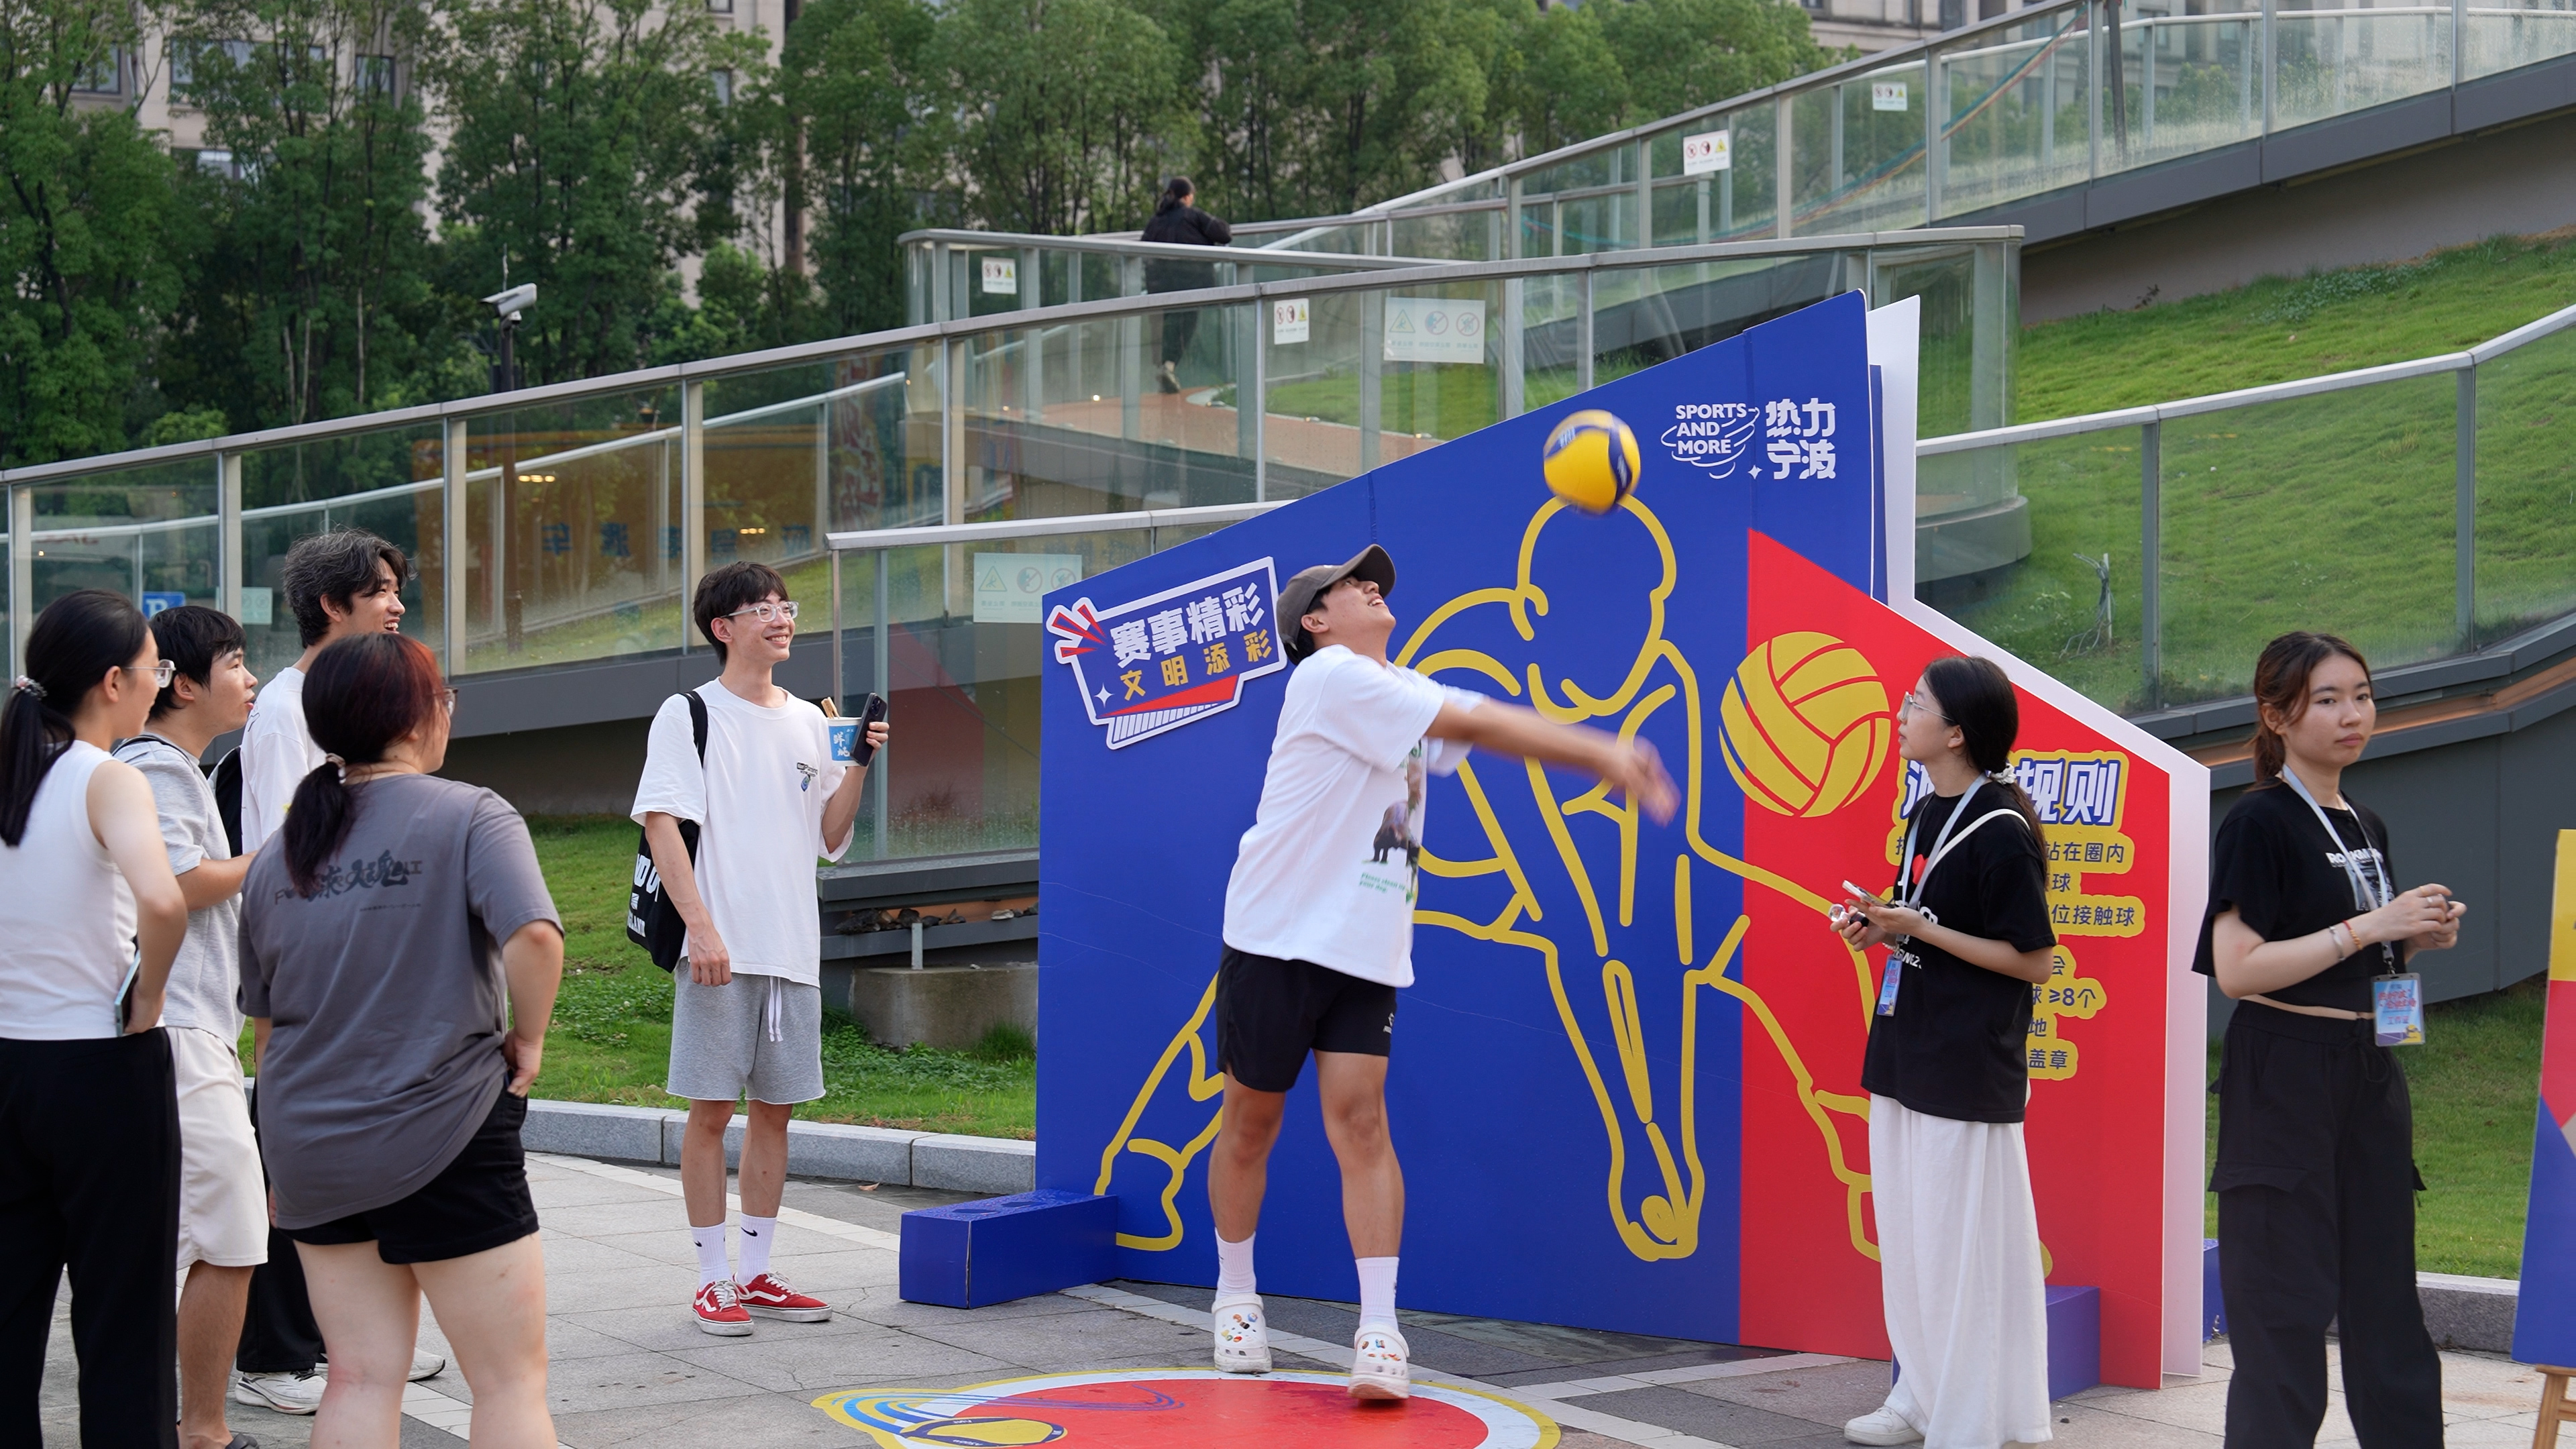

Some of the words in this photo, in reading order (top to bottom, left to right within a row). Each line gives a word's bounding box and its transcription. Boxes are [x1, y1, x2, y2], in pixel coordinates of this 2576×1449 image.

[1676, 403, 1747, 419] SPORTS
[1766, 398, 1836, 438] 热力
[1676, 422, 1720, 437] AND
[1678, 439, 1731, 455] MORE
[1766, 439, 1836, 480] 宁波
[146, 598, 168, 620] P
[1110, 582, 1265, 669] 赛事精彩
[1120, 629, 1273, 701] 文明添彩
[2028, 1016, 2047, 1037] 地
[2028, 1048, 2068, 1070] 盖章
